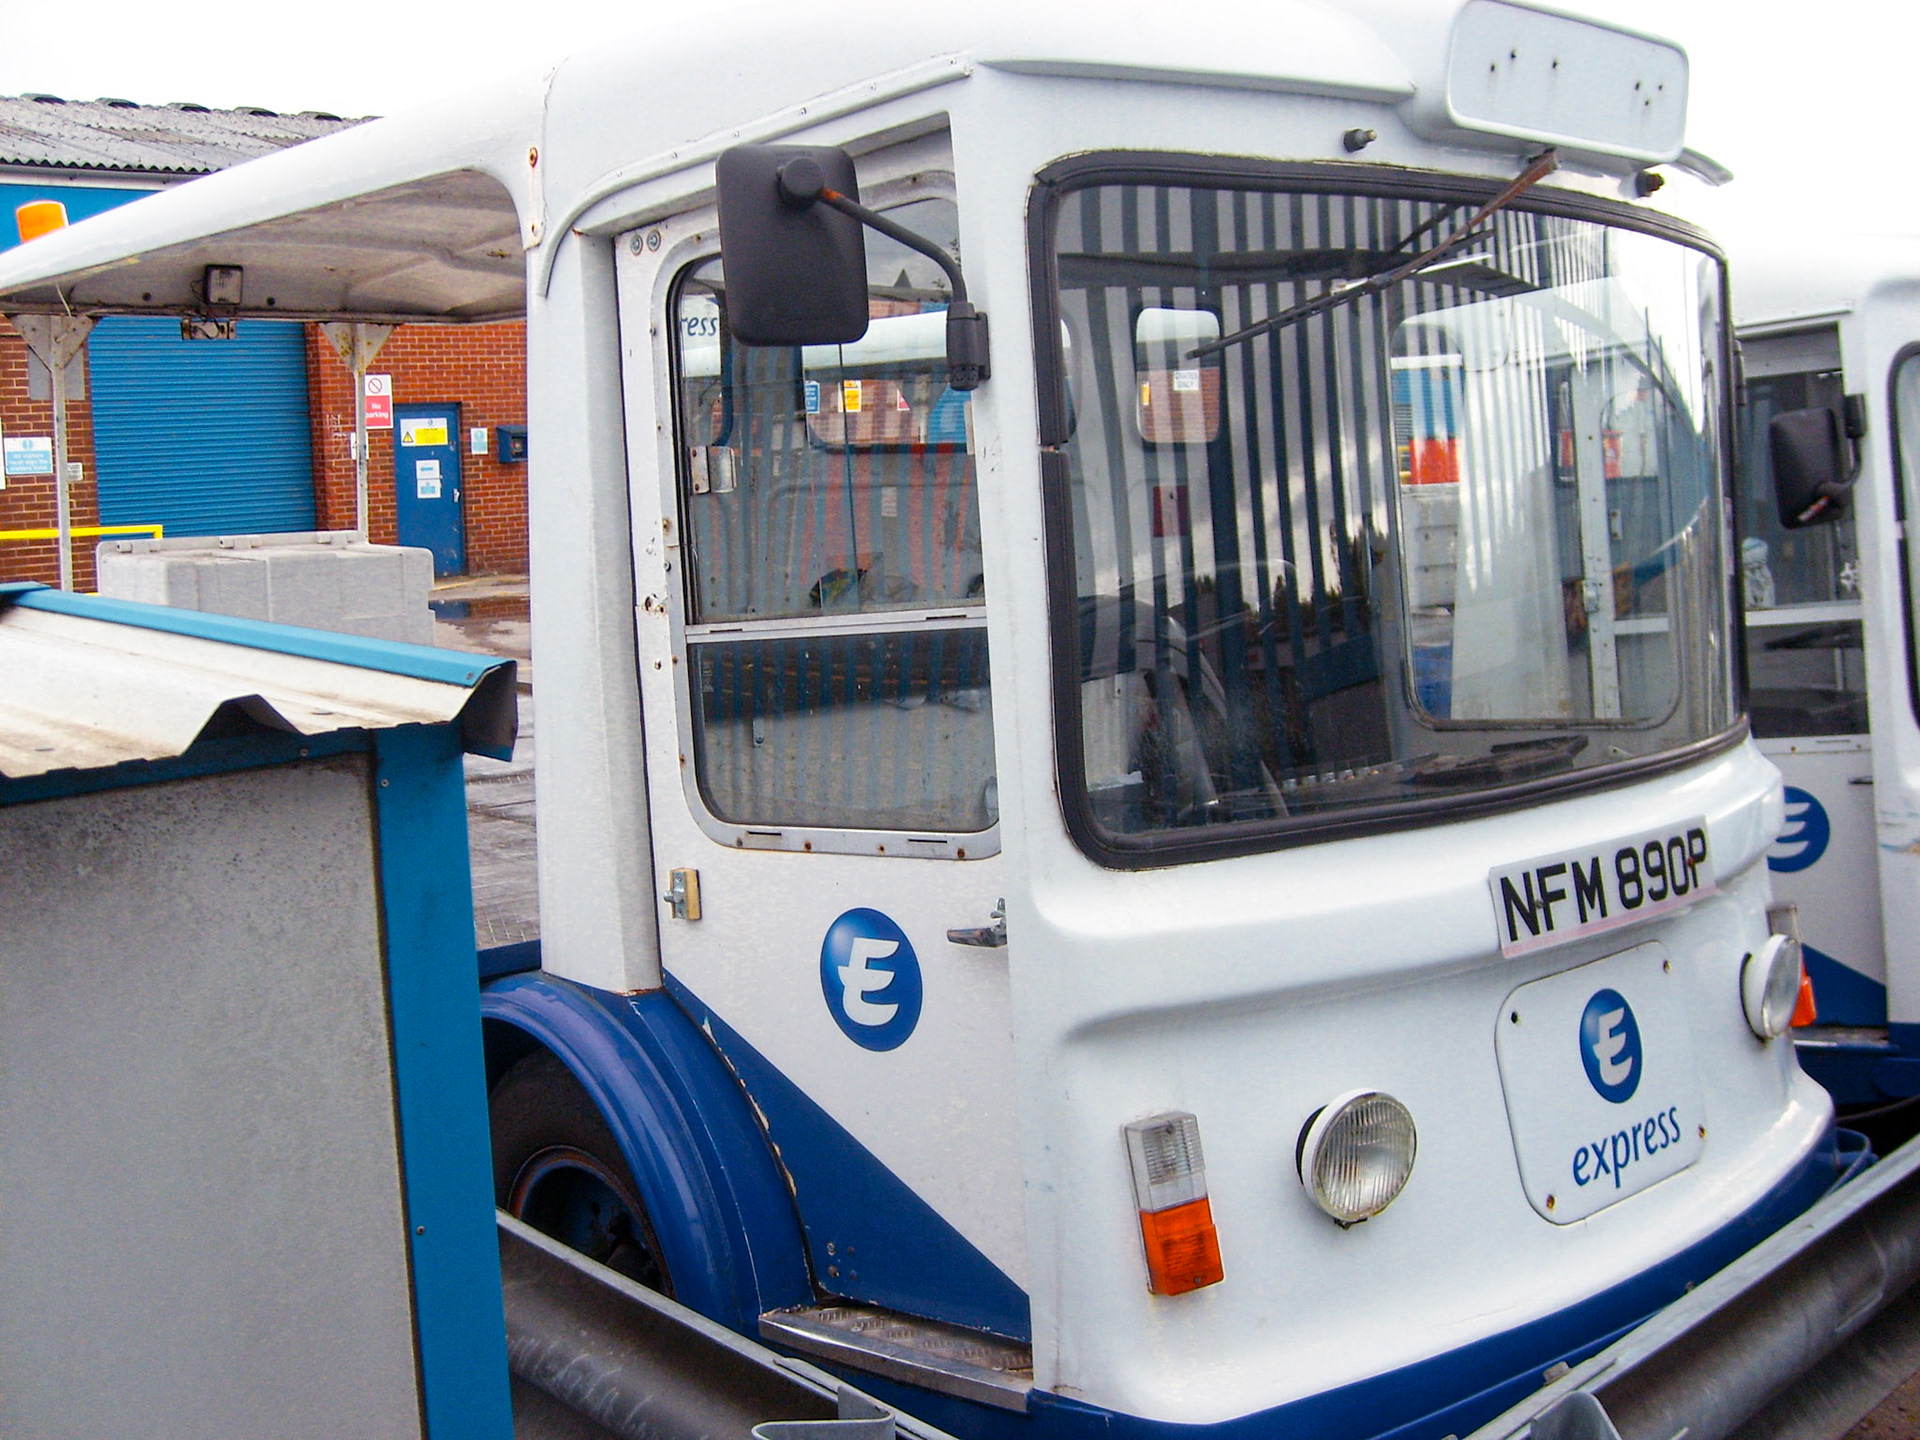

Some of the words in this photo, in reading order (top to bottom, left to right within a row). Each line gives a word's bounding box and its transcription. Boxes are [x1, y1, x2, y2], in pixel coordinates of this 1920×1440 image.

[1500, 857, 1608, 942] NFM
[1615, 828, 1707, 910] 890P
[1572, 1106, 1681, 1188] express
